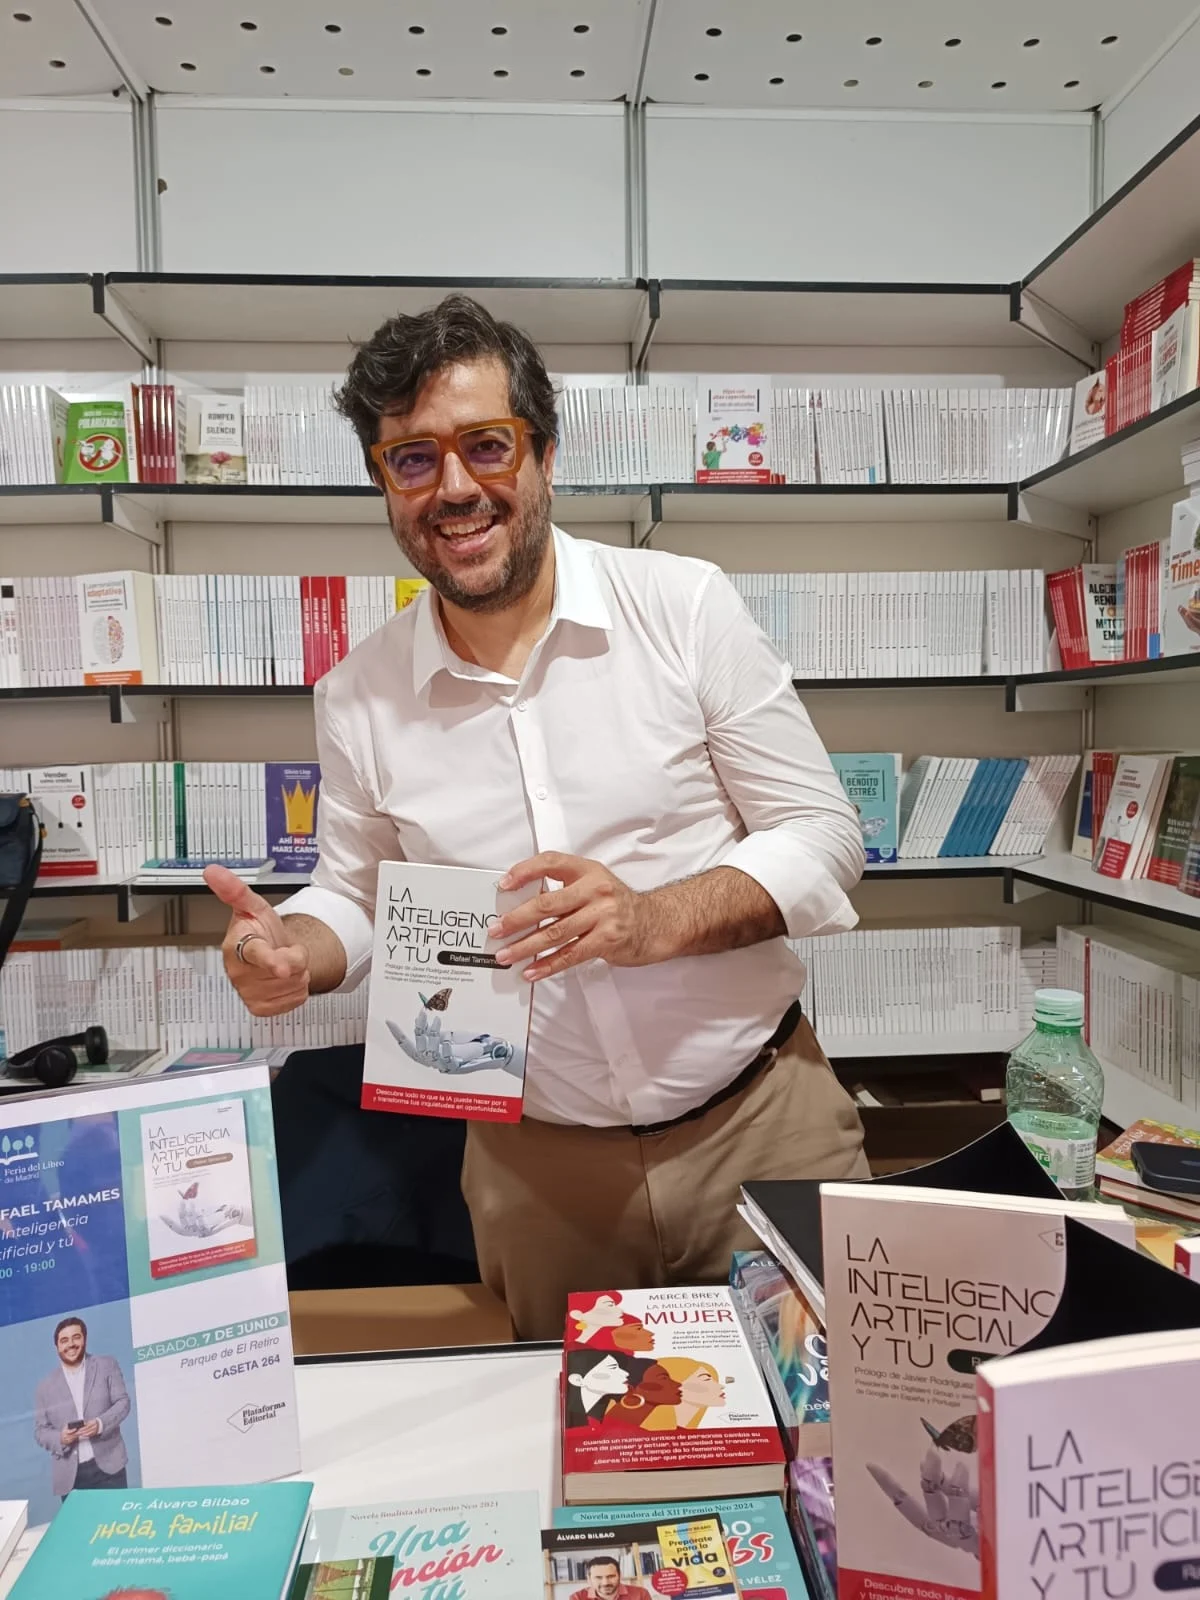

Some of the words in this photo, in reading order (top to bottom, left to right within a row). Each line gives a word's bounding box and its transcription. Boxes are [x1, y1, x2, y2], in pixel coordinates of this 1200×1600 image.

[206, 426, 236, 434] SILENCIO
[846, 777, 879, 786] BENDITO
[848, 787, 877, 796] ESTRÉS
[389, 885, 412, 903] LA
[388, 905, 501, 928] INTELIGENC
[386, 925, 482, 948] ARTIFICIAL
[386, 944, 398, 960] Y
[450, 954, 470, 962] Rafael
[376, 1088, 404, 1098] Descubre
[148, 1126, 166, 1138] LA
[150, 1127, 230, 1151] INTELIGENCIA
[152, 1144, 212, 1163] ARTIFICIAL
[4, 1166, 26, 1176] Feria
[28, 1163, 40, 1172] del
[41, 1160, 64, 1170] Libro
[16, 1172, 40, 1182] Madrid
[152, 1165, 160, 1176] Y
[0, 1204, 40, 1220] FAEL
[42, 1188, 120, 1212] TAMAMES
[2, 1214, 89, 1240] inteligencia
[45, 1240, 56, 1254] y
[58, 1234, 74, 1248] tú
[846, 1234, 890, 1264] LA
[24, 1258, 56, 1274] 19:00
[848, 1268, 1056, 1318] INTELIGENC
[645, 1310, 734, 1326] MUJER
[851, 1302, 1018, 1347] ARTIFICIAL
[136, 1336, 200, 1361] SÁBADO,
[202, 1334, 211, 1344] 7
[214, 1327, 234, 1342] DE
[236, 1316, 279, 1336] JUNIO
[852, 1334, 871, 1361] Y
[180, 1352, 218, 1368] Parque
[220, 1346, 234, 1358] de
[236, 1343, 247, 1354] El
[250, 1336, 280, 1351] Retiro
[213, 1360, 260, 1380] CASETA
[262, 1354, 280, 1368] 264
[854, 1366, 887, 1379] Prólogo
[902, 1374, 928, 1383] Javier
[242, 1401, 286, 1418] Plataforma
[243, 1410, 277, 1426] Editorial
[1028, 1429, 1083, 1472] LA
[1029, 1460, 1200, 1519] INTELIG
[122, 1501, 142, 1511] Dr.
[147, 1499, 198, 1510] Álvaro
[202, 1497, 250, 1508] Bilbao
[351, 1512, 379, 1521] Novela
[380, 1510, 413, 1519] finalista
[414, 1507, 428, 1515] del
[429, 1504, 460, 1514] Premio
[580, 1513, 609, 1521] Novela
[610, 1512, 650, 1521] ganadora
[682, 1506, 714, 1516] Premio
[714, 1504, 732, 1512] Neo
[734, 1502, 754, 1510] 2024
[90, 1514, 157, 1545] ¡Hola,
[168, 1510, 259, 1540] familia!
[557, 1532, 586, 1542] ÁLVARO
[588, 1531, 616, 1540] BILBAO
[368, 1520, 471, 1568] Una
[1030, 1508, 1200, 1566] ARTIFICI
[107, 1547, 119, 1555] El
[120, 1546, 161, 1556] primer
[162, 1542, 224, 1553] diccionario
[390, 1544, 503, 1592] nción
[672, 1552, 718, 1567] vida
[746, 1574, 782, 1585] VÉLEZ
[1030, 1572, 1056, 1600] Y
[860, 1592, 866, 1600] y
[864, 1578, 914, 1596] Descubre
[916, 1587, 942, 1600] todo
